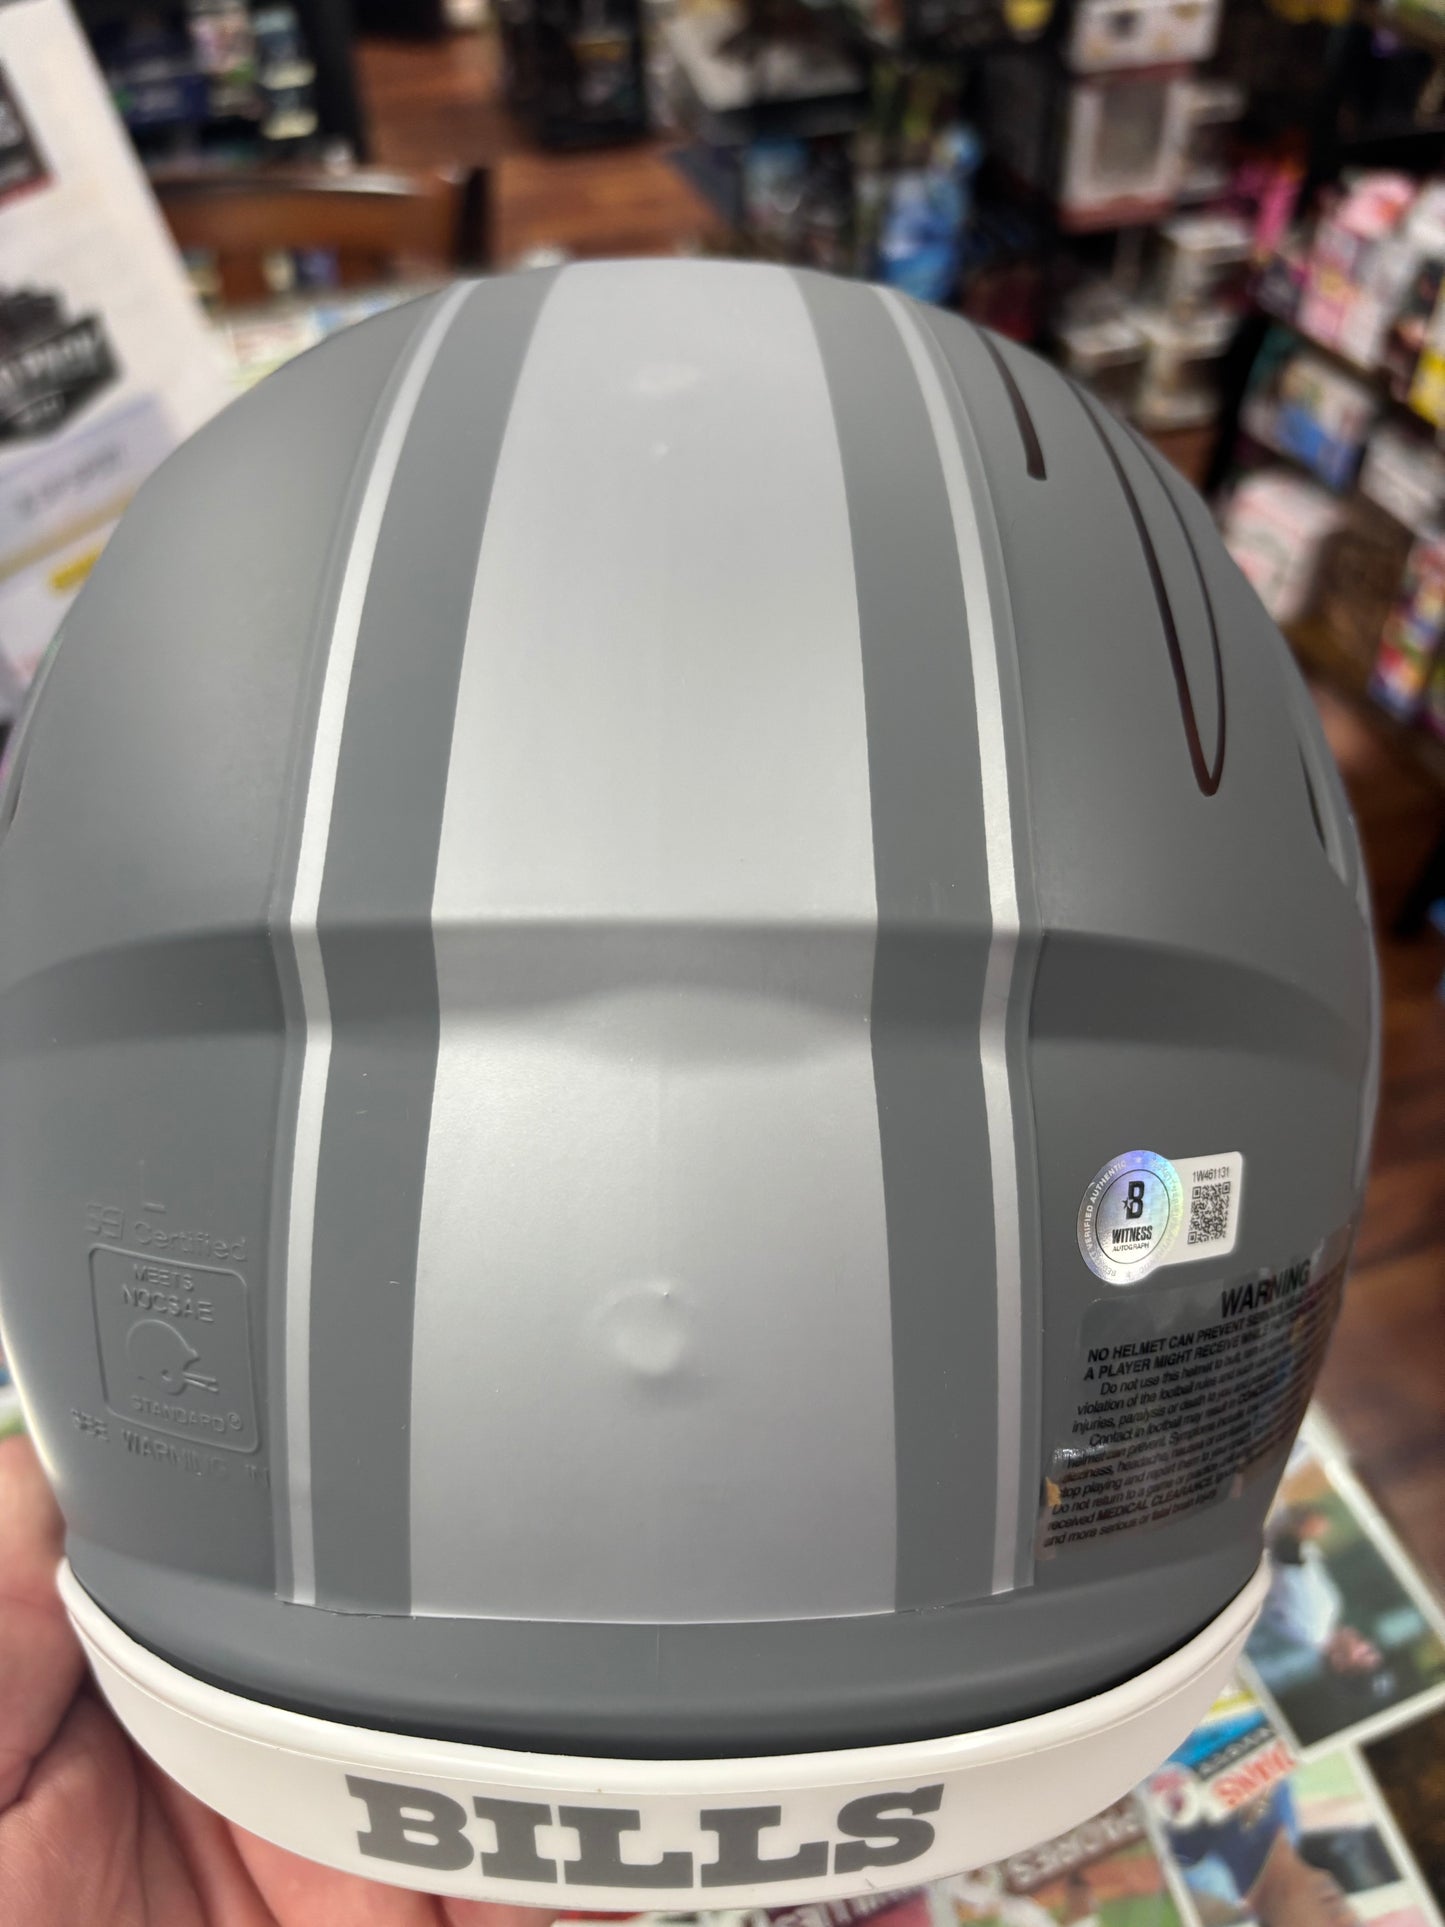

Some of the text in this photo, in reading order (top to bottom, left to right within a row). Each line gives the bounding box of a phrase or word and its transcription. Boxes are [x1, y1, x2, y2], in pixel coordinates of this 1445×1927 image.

[1192, 1166, 1231, 1183] 1W461131
[1084, 1205, 1094, 1250] VERIFIED
[1090, 1160, 1127, 1204] AUTHENTIC
[134, 1220, 248, 1262] Certified
[1112, 1225, 1153, 1244] WITNESS
[1112, 1242, 1150, 1252] AUTOGRAPH
[133, 1263, 194, 1291] MEETS
[1221, 1259, 1310, 1319] WARNING
[121, 1283, 215, 1323] NOCSAE
[1087, 1348, 1110, 1363] NO
[1112, 1338, 1168, 1360] HELMET
[1168, 1332, 1195, 1349] CAN
[1196, 1318, 1245, 1344] PREVENT
[1084, 1366, 1095, 1380] A
[1098, 1358, 1152, 1379] PLAYER
[1153, 1349, 1193, 1369] MIGHT
[1194, 1337, 1239, 1361] RECEIVE
[1077, 1399, 1124, 1416] violation
[1126, 1393, 1139, 1409] of
[1140, 1391, 1157, 1405] the
[1159, 1379, 1195, 1400] football
[1100, 1381, 1117, 1396] Do
[1120, 1378, 1138, 1392] not
[1139, 1375, 1160, 1389] use
[1162, 1370, 1180, 1384] this
[1072, 1416, 1116, 1436] injuries,
[1118, 1405, 1166, 1429] paralysis
[1167, 1402, 1180, 1415] or
[1089, 1429, 1134, 1448] Contact
[1134, 1427, 1146, 1439] in
[1146, 1414, 1182, 1436] football
[1071, 1498, 1090, 1513] not
[1091, 1490, 1124, 1508] return
[1125, 1487, 1137, 1501] to
[1081, 1478, 1123, 1499] playing
[1048, 1512, 1096, 1532] received
[1095, 1499, 1150, 1522] MEDICAL
[1043, 1531, 1068, 1548] and
[1067, 1528, 1099, 1543] more
[344, 1773, 945, 1890] BILLS
